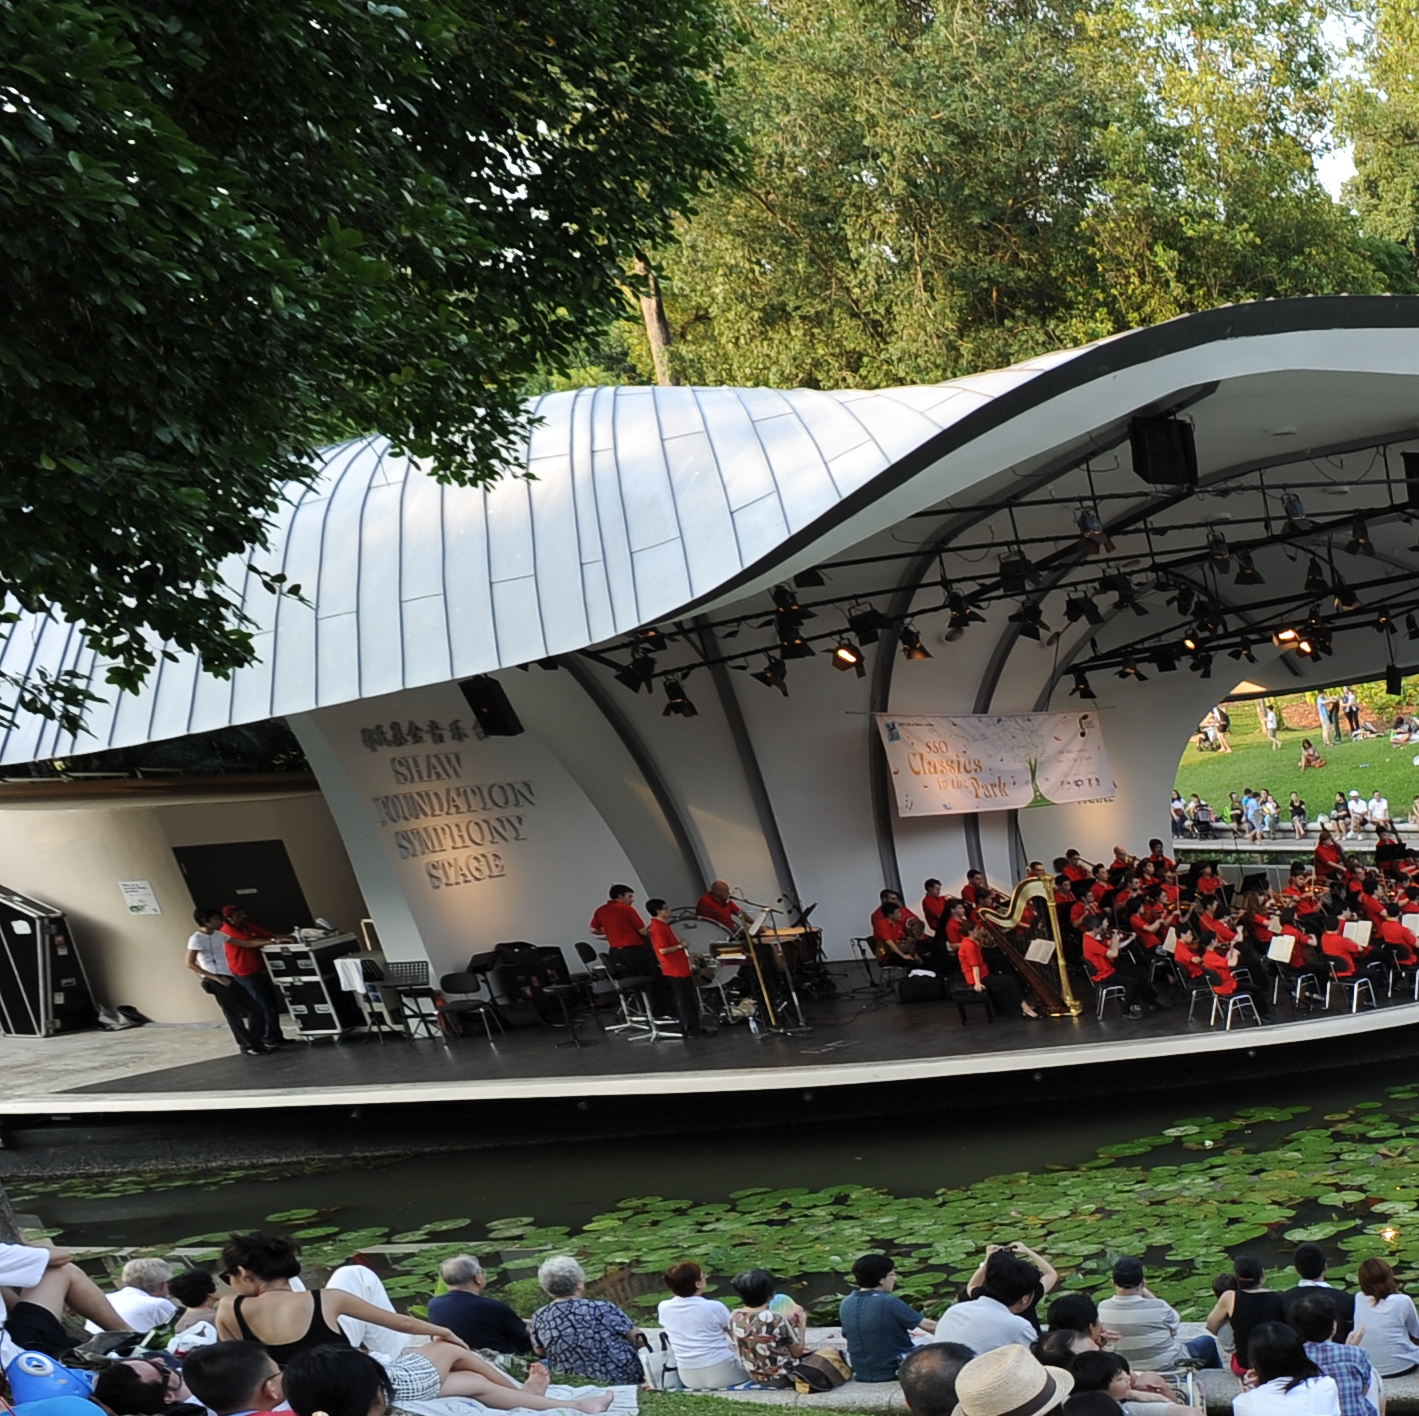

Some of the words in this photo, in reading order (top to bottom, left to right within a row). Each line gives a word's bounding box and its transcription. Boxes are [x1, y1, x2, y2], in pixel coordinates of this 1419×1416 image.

[925, 740, 949, 754] SSO
[389, 752, 462, 785] SHAW
[907, 752, 983, 776] Classics
[372, 780, 536, 827] FOUNDATION
[969, 776, 1009, 799] Park
[393, 814, 527, 860] SYMPHONY
[425, 851, 506, 890] STAGE
